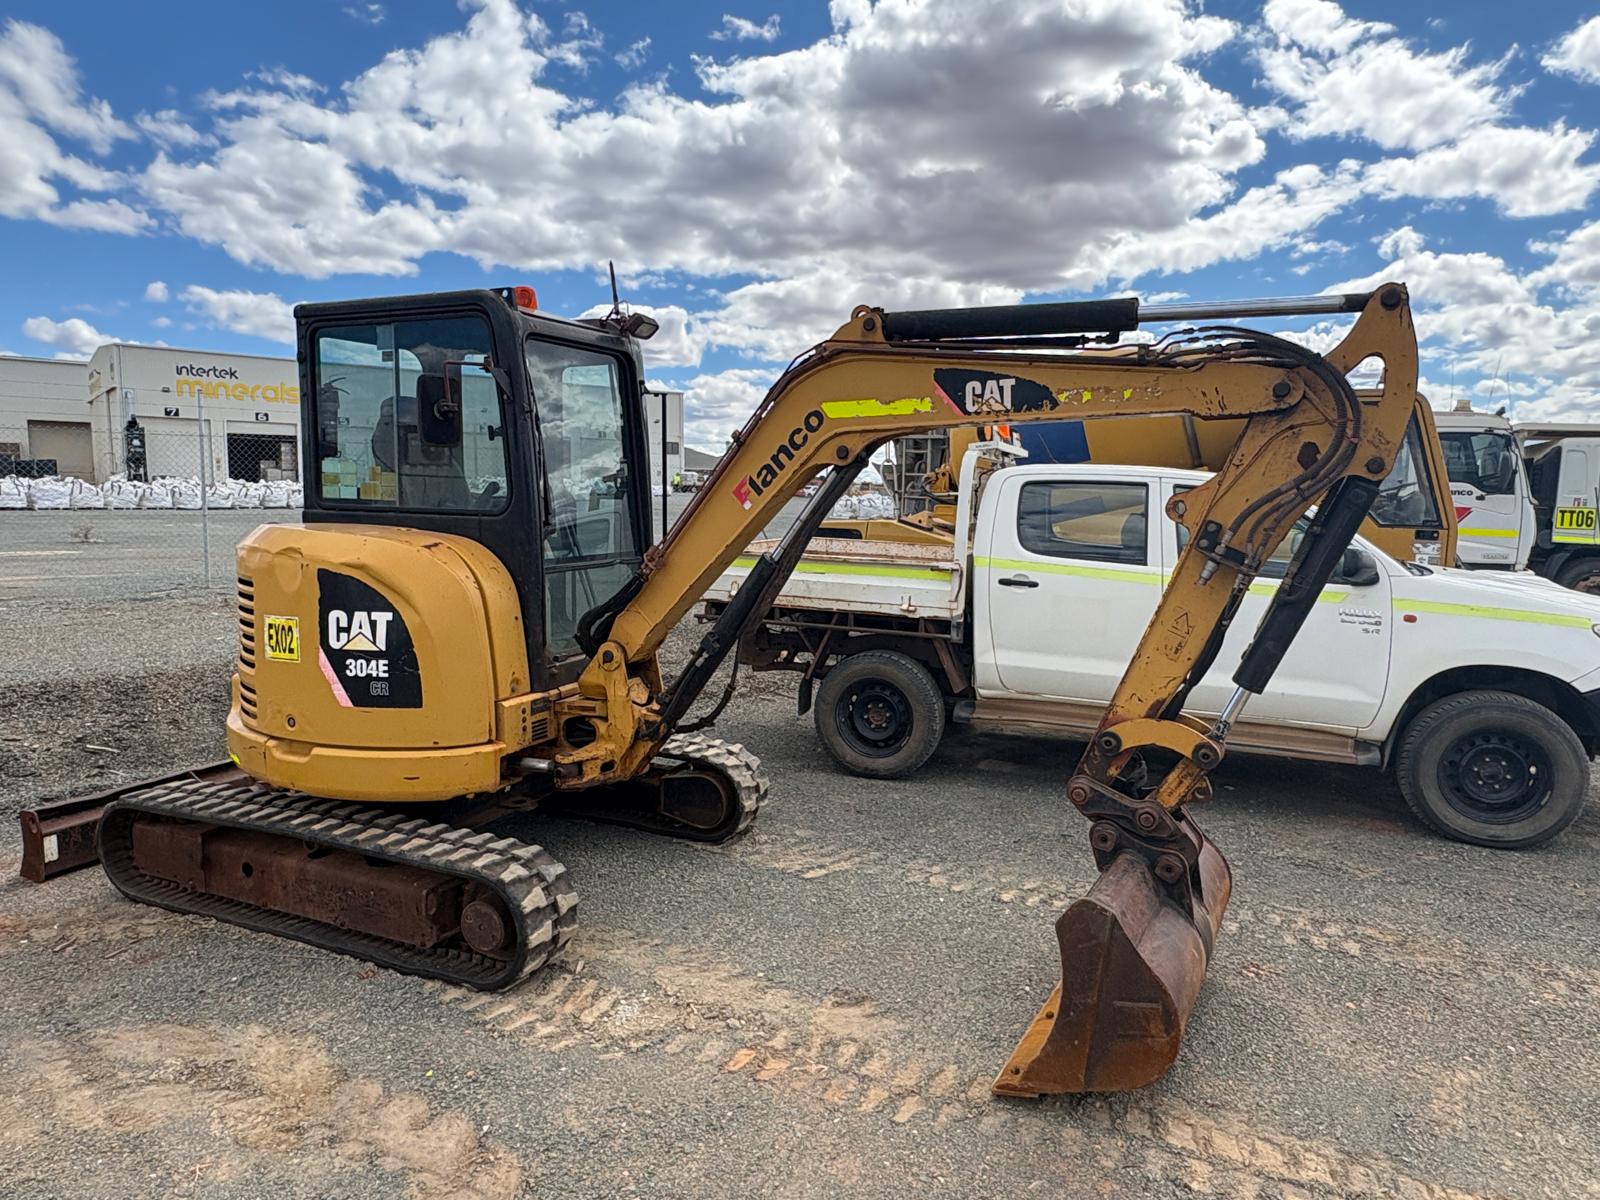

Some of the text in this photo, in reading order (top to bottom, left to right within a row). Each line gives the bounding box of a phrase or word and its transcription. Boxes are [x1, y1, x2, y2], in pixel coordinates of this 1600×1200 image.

[176, 364, 239, 380] intertek
[175, 379, 300, 405] minerals
[965, 378, 1016, 413] CAT
[167, 408, 177, 416] 7
[257, 412, 266, 421] 6
[732, 410, 825, 510] Flanco
[1559, 509, 1594, 528] TT06
[267, 621, 295, 655] EX02
[327, 609, 393, 652] CAT
[345, 658, 389, 678] 304E
[369, 681, 389, 696] CR
